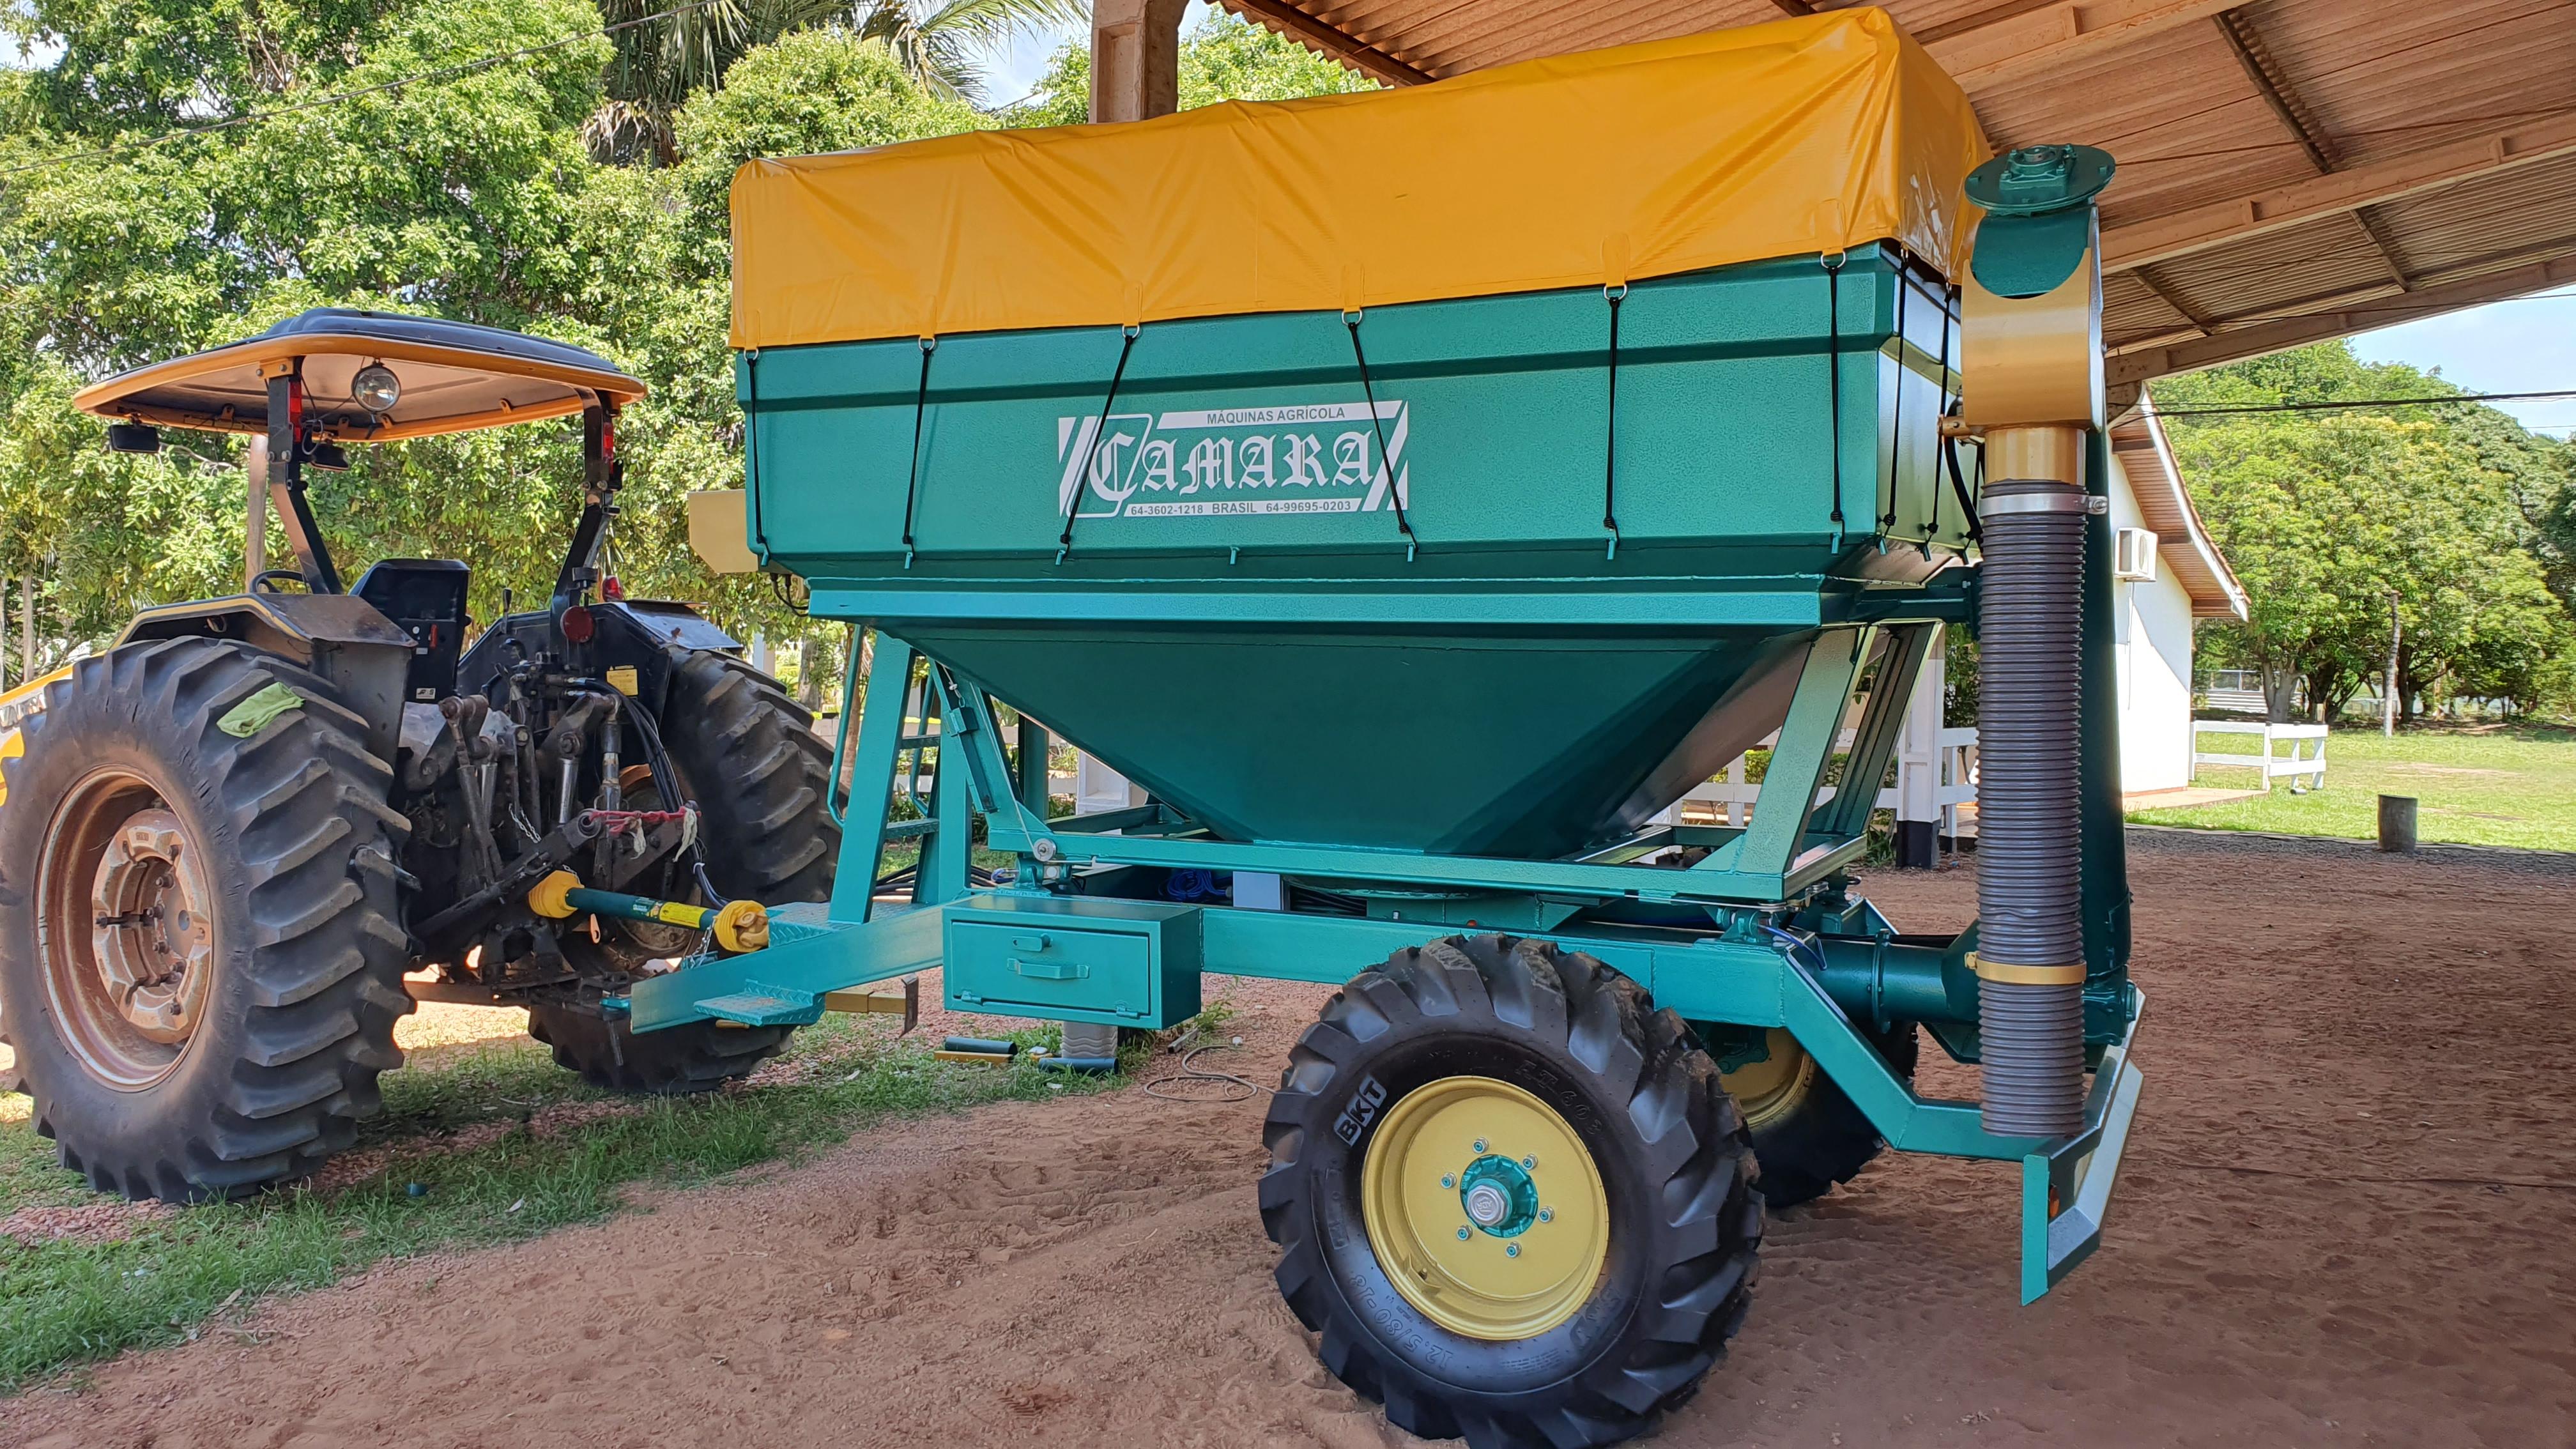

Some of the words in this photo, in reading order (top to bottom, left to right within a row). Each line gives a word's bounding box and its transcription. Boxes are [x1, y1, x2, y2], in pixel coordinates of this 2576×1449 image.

[1207, 410, 1273, 425] MÁQUINAS
[1277, 406, 1346, 421] AGRÍCOLA
[1131, 505, 1204, 516] 64-3602-1218
[1212, 502, 1257, 514] BRASIL
[1266, 500, 1351, 513] 64-99695-0203
[1335, 1077, 1384, 1144] BKT
